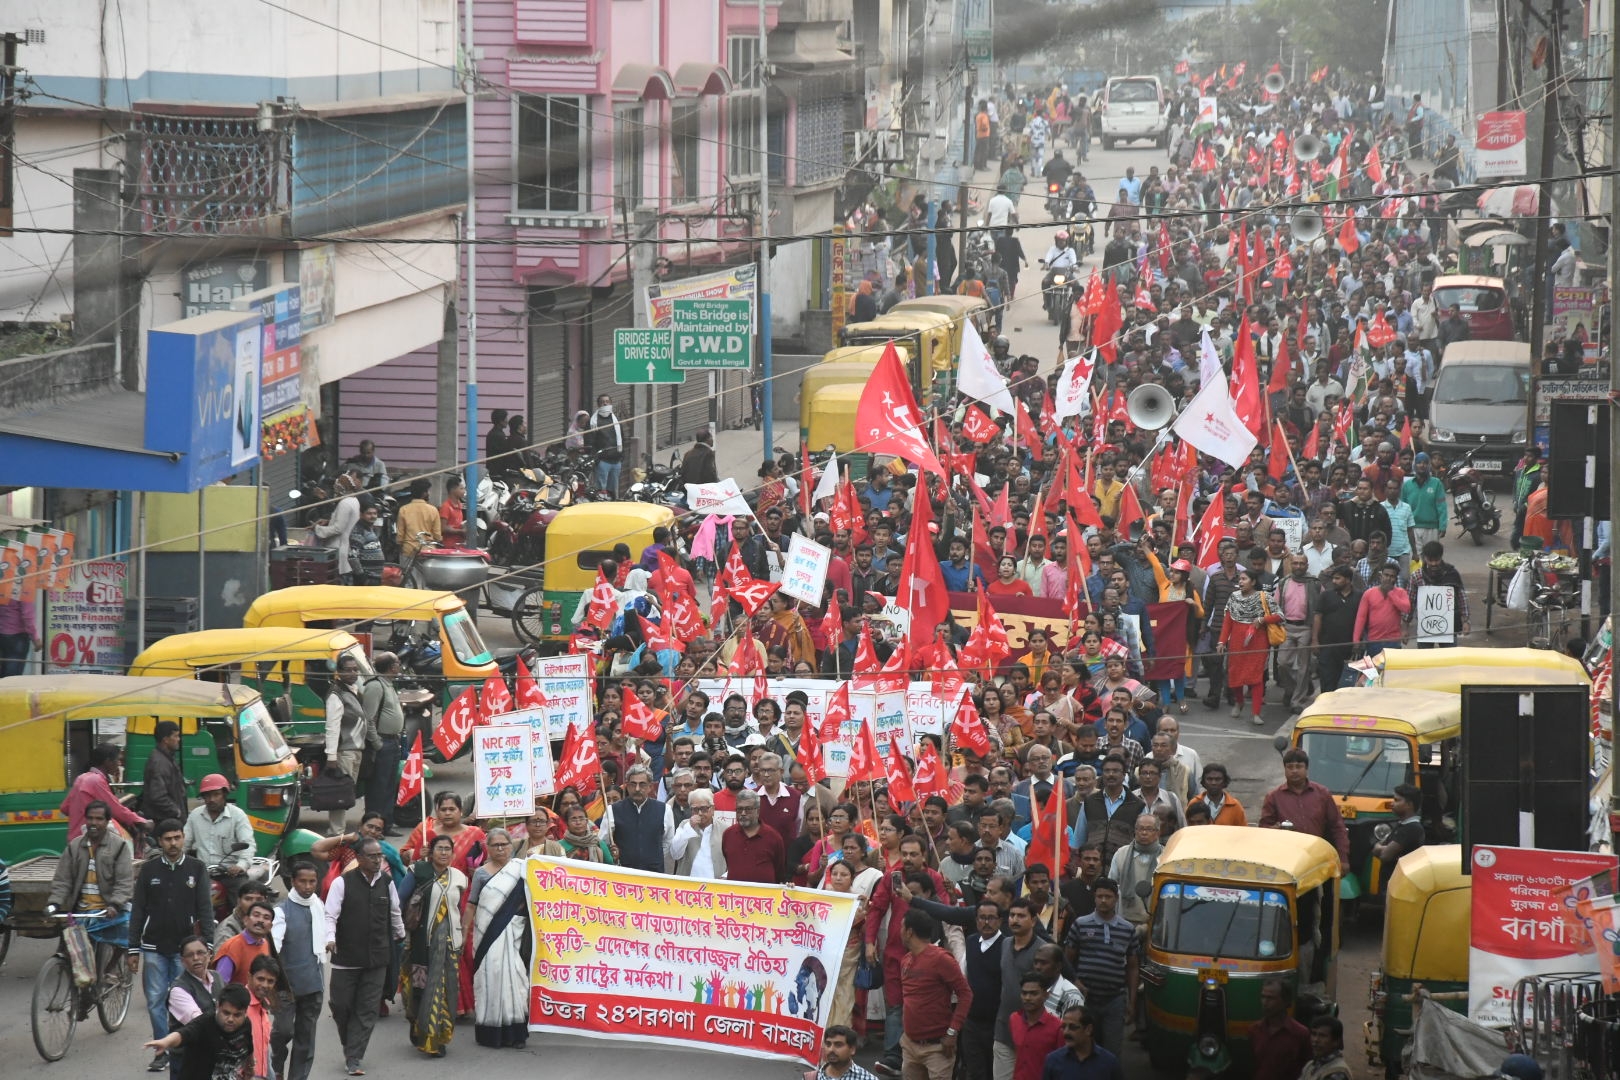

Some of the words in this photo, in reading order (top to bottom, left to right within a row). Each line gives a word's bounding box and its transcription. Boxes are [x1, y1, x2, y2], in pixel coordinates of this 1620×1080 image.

[187, 264, 223, 281] New
[675, 310, 698, 320] This
[700, 310, 736, 322] Bridge
[739, 310, 748, 320] is
[674, 322, 732, 333] Maintained
[735, 322, 749, 335] by
[618, 332, 650, 345] BRIDGE
[679, 336, 743, 353] P.W.D
[624, 347, 649, 360] DRIVE
[722, 359, 745, 367] Bengal
[1425, 593, 1443, 611] NO
[1426, 619, 1445, 629] NRC
[482, 737, 504, 750] NRC
[1479, 853, 1491, 862] 27
[1494, 872, 1524, 883] সকাল
[535, 866, 609, 896] স্বাধীনতার
[612, 881, 645, 902] জন্য
[647, 886, 670, 903] সব
[674, 884, 713, 907] ধর্মের
[717, 892, 774, 917] মানুষের
[777, 891, 833, 921] ঐক্যবদ্ধ
[1509, 885, 1550, 897] পরিষেবা
[1511, 899, 1545, 912] সুরক্ষা
[631, 911, 711, 937] আত্মত্যাগের
[595, 935, 649, 957] এদেশের
[744, 946, 789, 976] ঐতিহ্য
[538, 959, 571, 983] ভারত
[575, 960, 620, 989] রাষ্ট্রের
[538, 991, 587, 1021] উত্তর
[704, 1014, 755, 1040] জেলা
